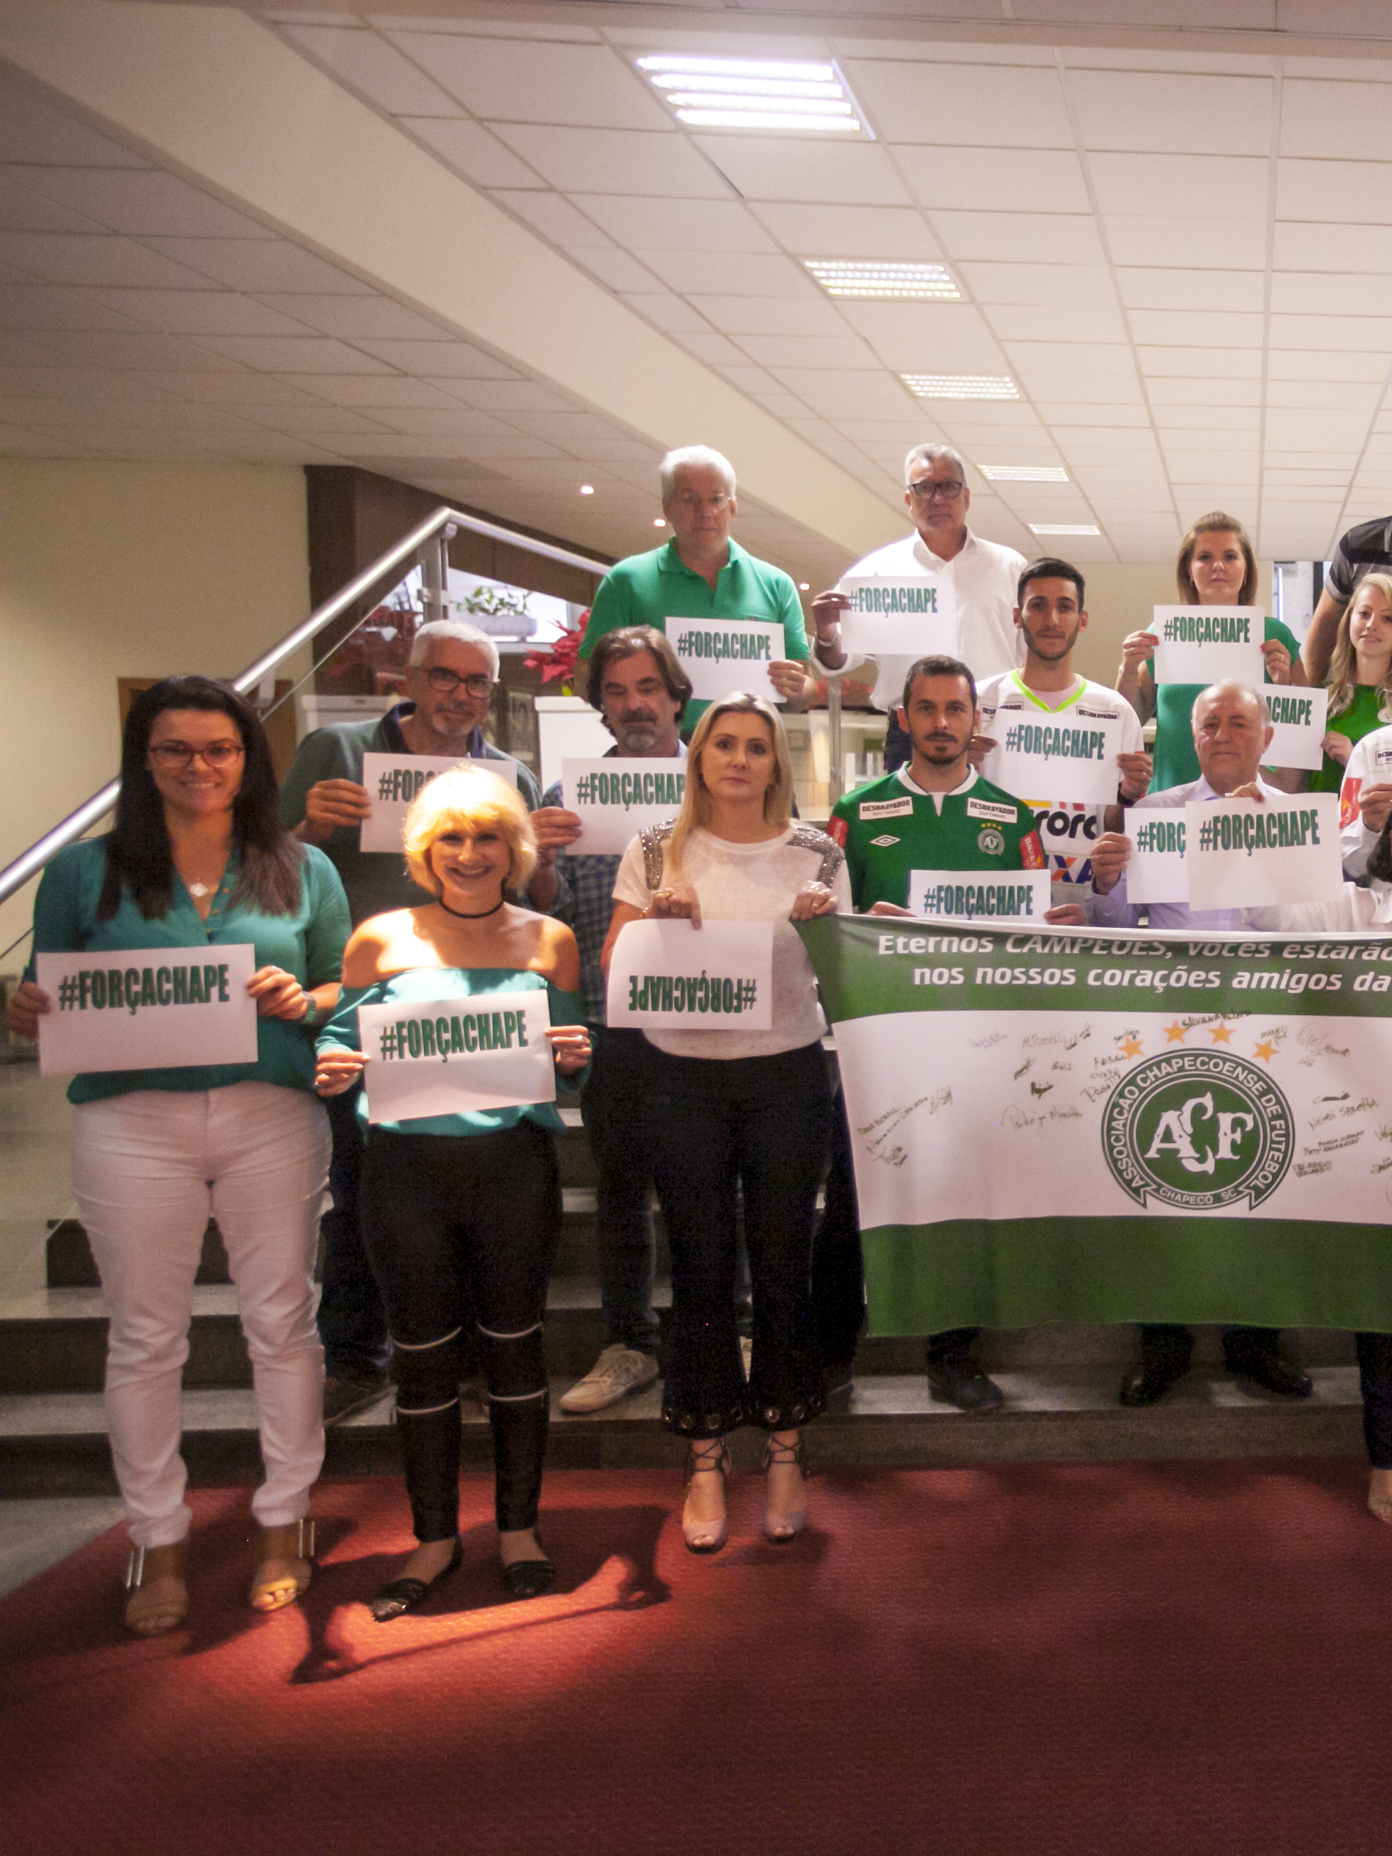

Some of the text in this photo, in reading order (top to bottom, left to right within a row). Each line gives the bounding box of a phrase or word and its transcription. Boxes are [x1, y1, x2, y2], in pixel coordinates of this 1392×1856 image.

[849, 587, 938, 618] #FORÇACHAPE
[677, 631, 772, 664] #FORÇACHAPE
[1163, 616, 1251, 648] #FORÇACHAPE
[1005, 724, 1106, 761] #FORÇACHAPE
[576, 773, 687, 812] #FORÇACHAP
[1199, 808, 1321, 857] #FORÇACHAPE
[924, 885, 1034, 921] #FORÇACHAPE
[878, 935, 994, 956] Eternos
[58, 964, 230, 1016] #FORÇACHAPE
[912, 966, 965, 985] nos
[974, 967, 1077, 986] nossos
[1086, 965, 1222, 993] corações
[1231, 969, 1344, 994] amigos
[1353, 970, 1392, 993] da
[379, 1010, 529, 1063] #FORÇACHAPE
[1136, 1056, 1268, 1096] CHAPECOENSE
[1261, 1093, 1282, 1118] DE
[1110, 1085, 1146, 1188] ASSOCIAÇÃO
[1249, 1120, 1286, 1190] FUTEBOL
[1221, 1188, 1238, 1201] SC
